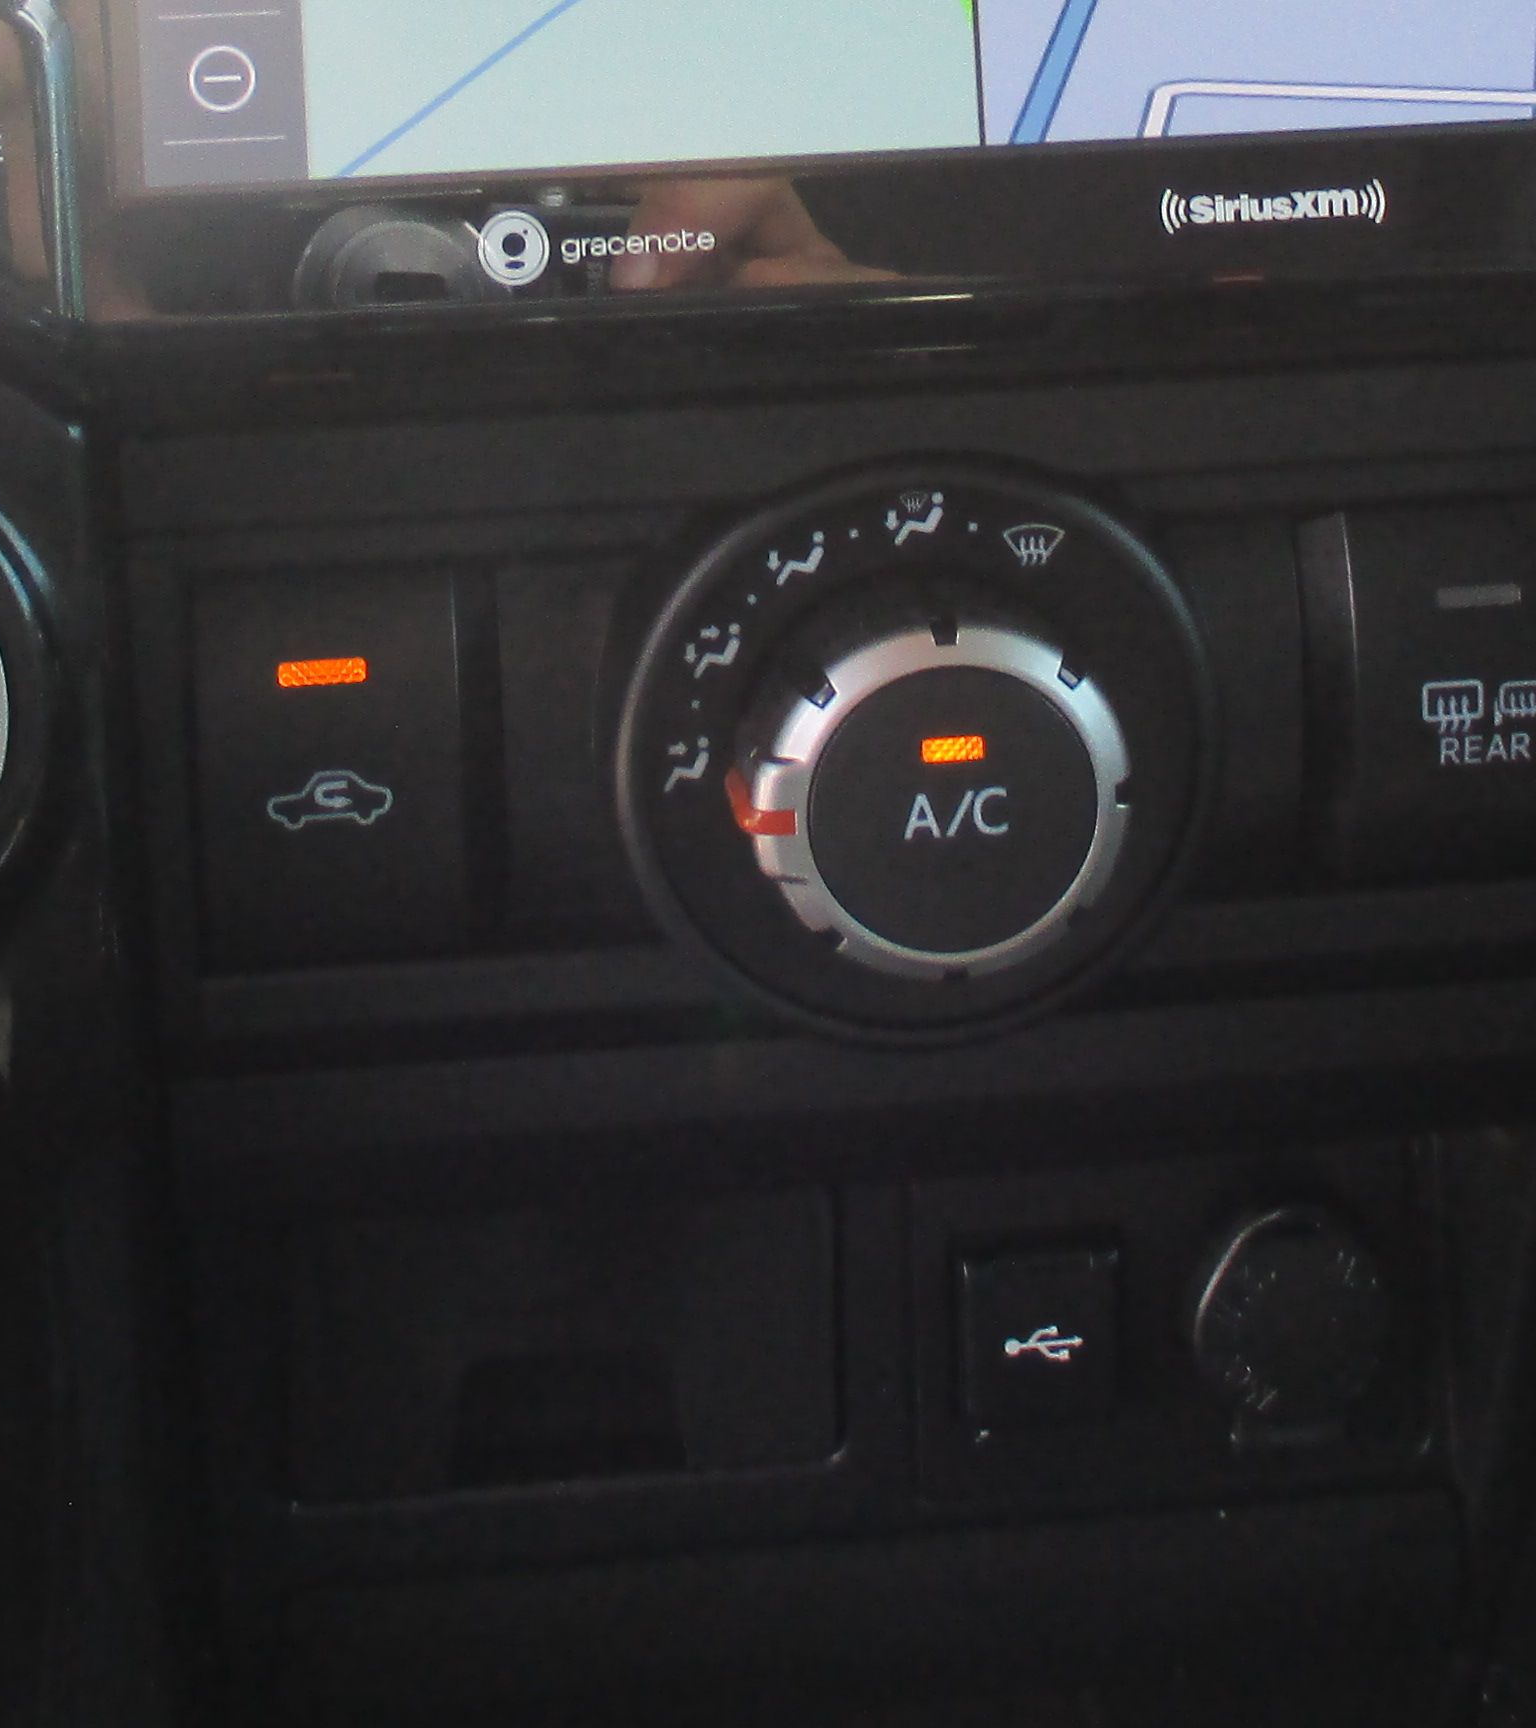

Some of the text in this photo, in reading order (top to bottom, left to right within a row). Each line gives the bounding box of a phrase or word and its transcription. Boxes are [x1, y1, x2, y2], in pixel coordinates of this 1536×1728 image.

[561, 228, 716, 264] gracenote
[1438, 731, 1532, 767] REAR
[903, 787, 1010, 842] A/C
